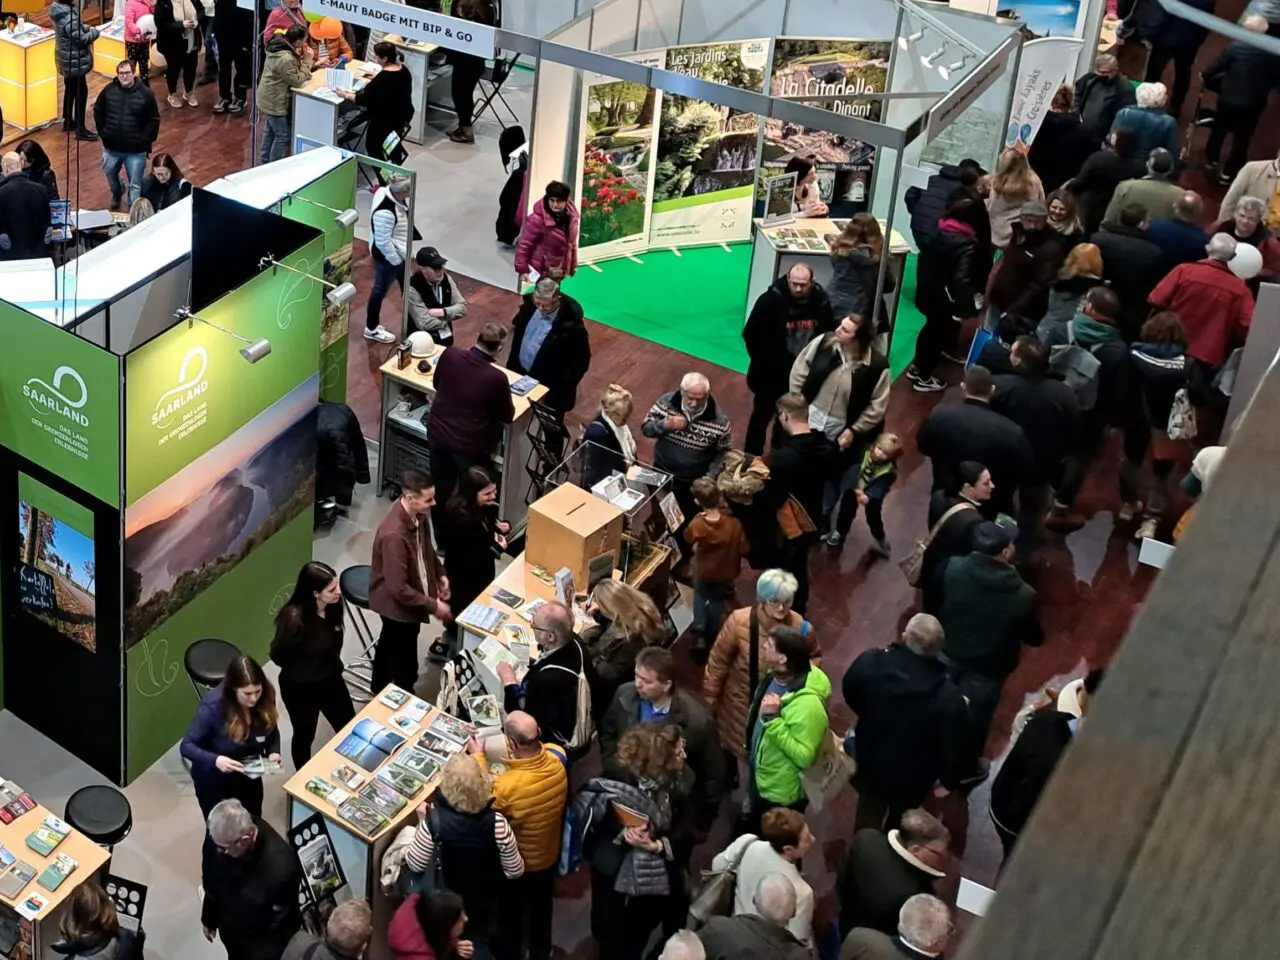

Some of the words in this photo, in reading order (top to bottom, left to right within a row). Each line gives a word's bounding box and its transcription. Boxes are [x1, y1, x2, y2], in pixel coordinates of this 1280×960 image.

[362, 7, 396, 23] BADGE
[400, 17, 420, 30] MIT
[422, 22, 442, 34] BIP
[445, 28, 453, 37] &
[456, 31, 473, 42] GO
[671, 50, 688, 65] Les
[690, 49, 727, 64] Jardins
[781, 74, 800, 96] La
[805, 76, 874, 96] Citadelle
[833, 99, 871, 116] Dinant
[23, 384, 89, 427] SAARLAND
[151, 380, 208, 425] SAARLAND
[183, 412, 194, 422] DAS
[194, 402, 207, 416] LAND
[32, 417, 43, 428] DER
[44, 424, 88, 452] GRENZENLOSEN
[59, 424, 71, 436] DAS
[72, 431, 88, 444] LAND
[158, 436, 169, 446] DER
